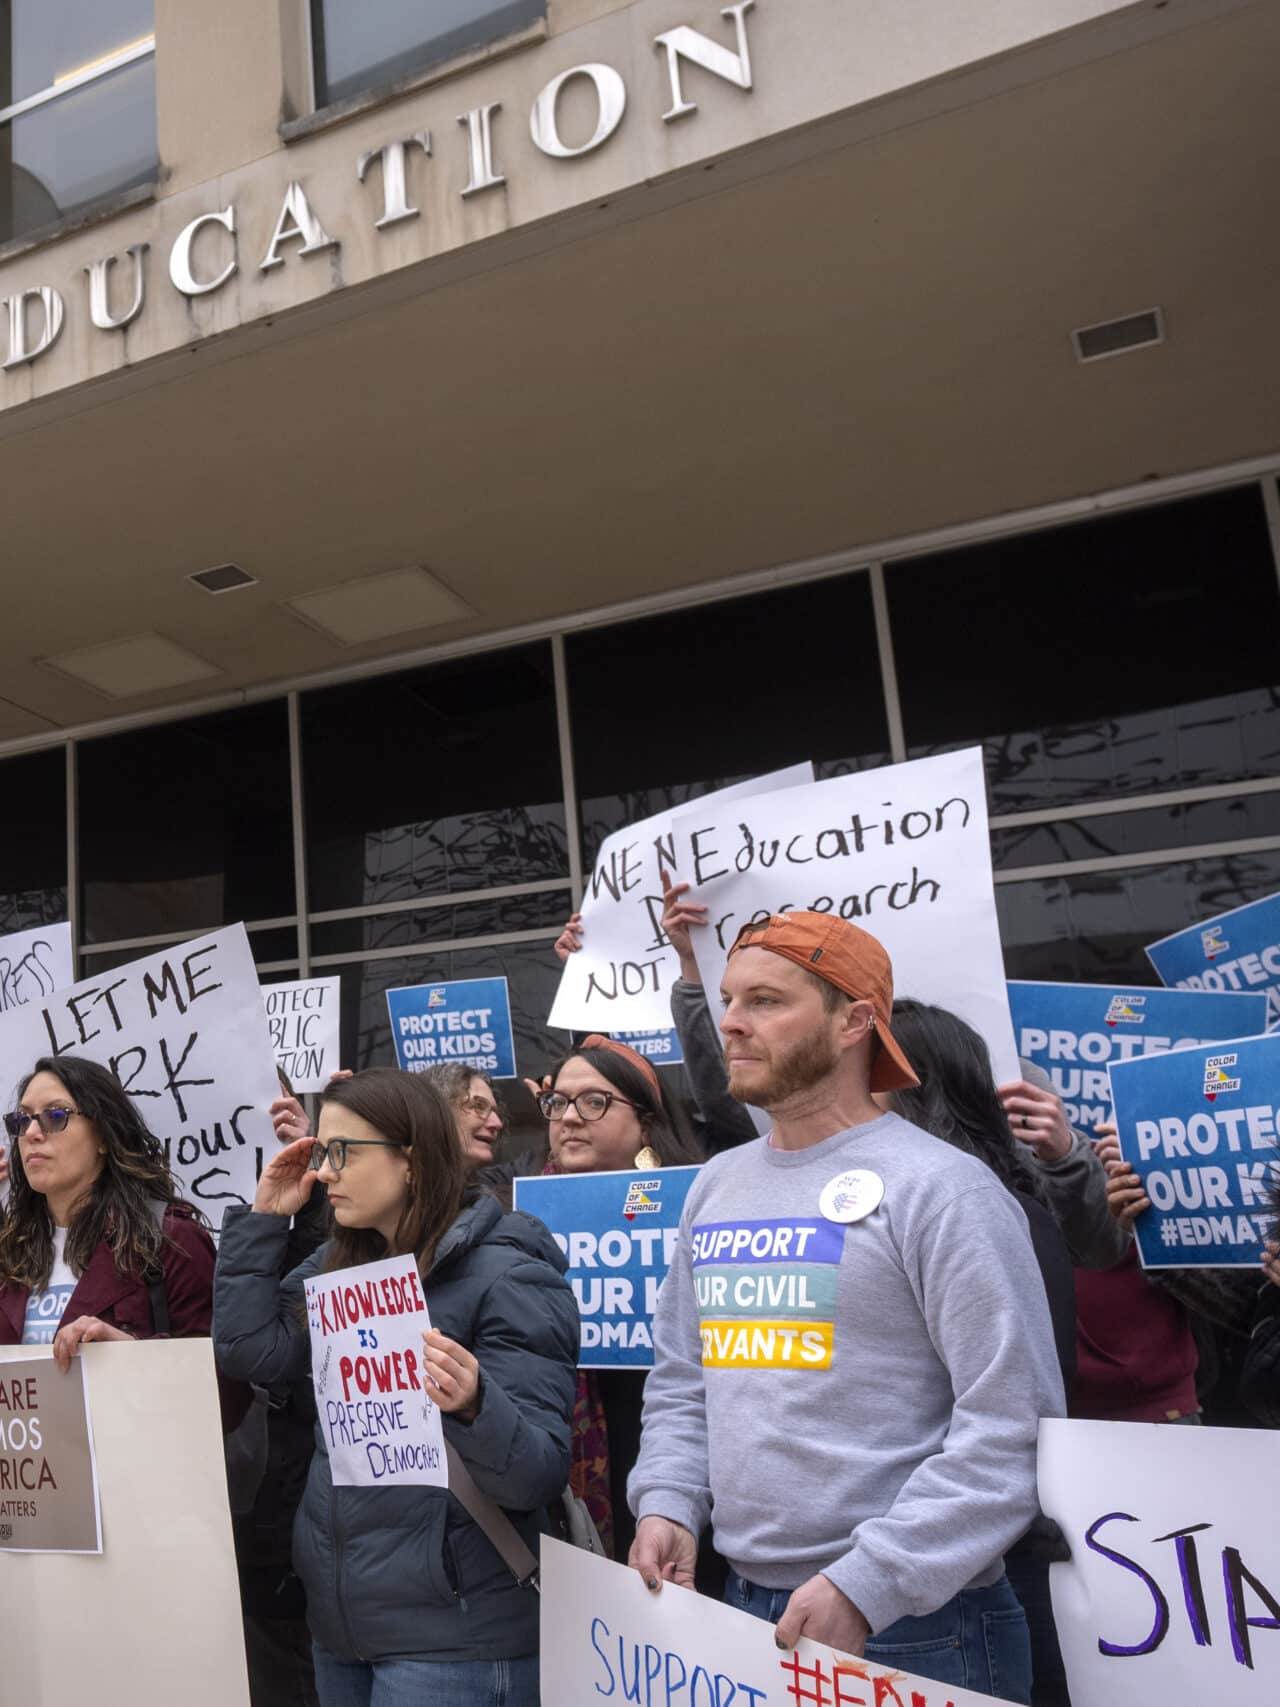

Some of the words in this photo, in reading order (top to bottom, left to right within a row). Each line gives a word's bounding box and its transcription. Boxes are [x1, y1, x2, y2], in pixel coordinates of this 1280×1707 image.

[690, 797, 970, 886] Education
[592, 841, 643, 903] WE
[715, 867, 941, 950] rearch
[585, 957, 667, 1003] NOT
[42, 979, 127, 1056] LET
[143, 944, 223, 1018] ME
[266, 986, 331, 1015] OTECT
[268, 1014, 321, 1049] BLIC
[399, 1008, 492, 1036] PROTECT
[403, 1038, 437, 1058] OUR
[440, 1033, 496, 1055] KIDS
[1207, 1055, 1236, 1067] COLOR
[109, 1032, 215, 1122] RK
[1048, 1067, 1111, 1102] UR
[1206, 1070, 1217, 1080] OF
[1136, 1105, 1280, 1161] PROTE
[628, 1193, 640, 1201] OF
[631, 1182, 660, 1190] COLOR
[1146, 1166, 1234, 1211] OUR
[624, 1203, 660, 1212] CHANGE
[692, 1227, 817, 1261] SUPPORT
[1160, 1214, 1277, 1247] #EDMAT
[317, 1272, 424, 1336] KNOWLEDGE
[572, 1277, 635, 1315] UR
[694, 1276, 728, 1309] UR
[733, 1275, 816, 1308] CIVIL
[357, 1329, 378, 1349] IS
[339, 1349, 422, 1402] POWER
[326, 1400, 408, 1448] PRESERVE
